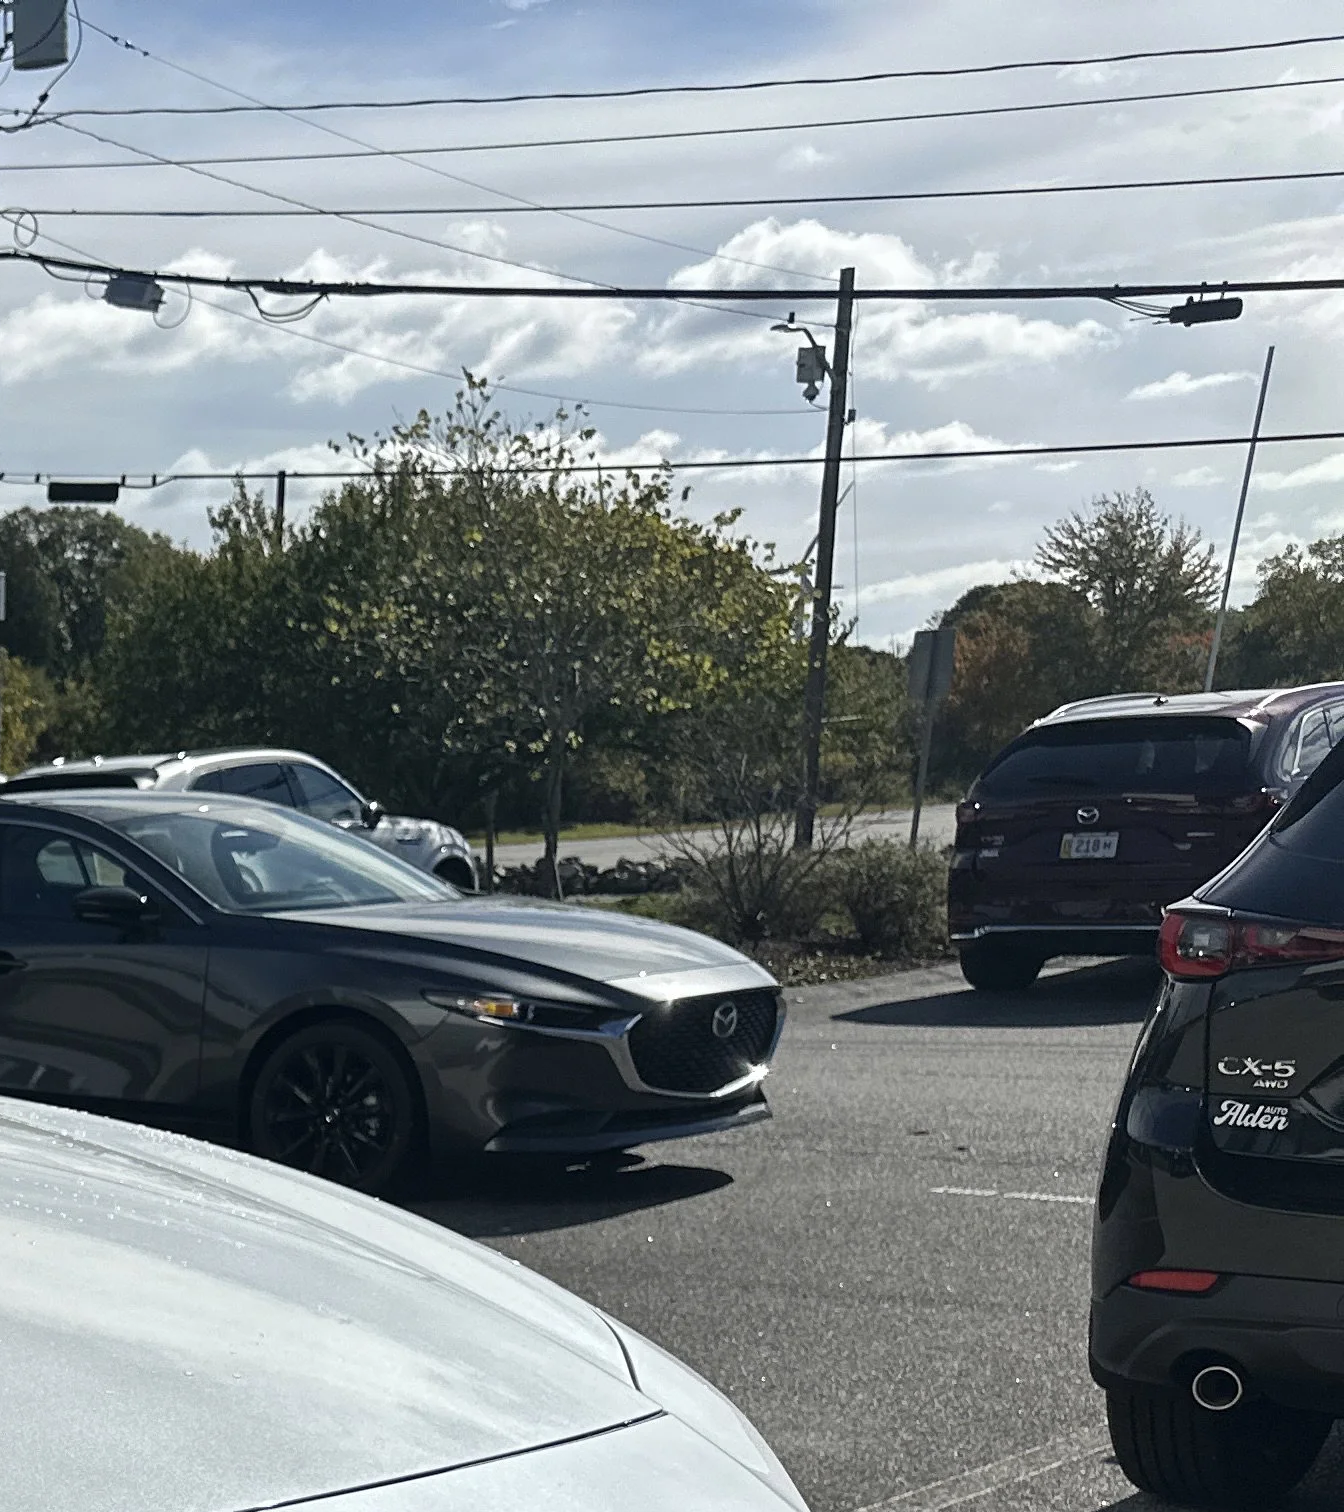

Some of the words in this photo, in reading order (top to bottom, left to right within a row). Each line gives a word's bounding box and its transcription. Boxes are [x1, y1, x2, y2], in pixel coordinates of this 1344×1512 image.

[1217, 1056, 1296, 1078] CX-5
[1253, 1080, 1289, 1089] AWD
[1213, 1100, 1290, 1131] Alden
[1264, 1106, 1289, 1116] AUTO
